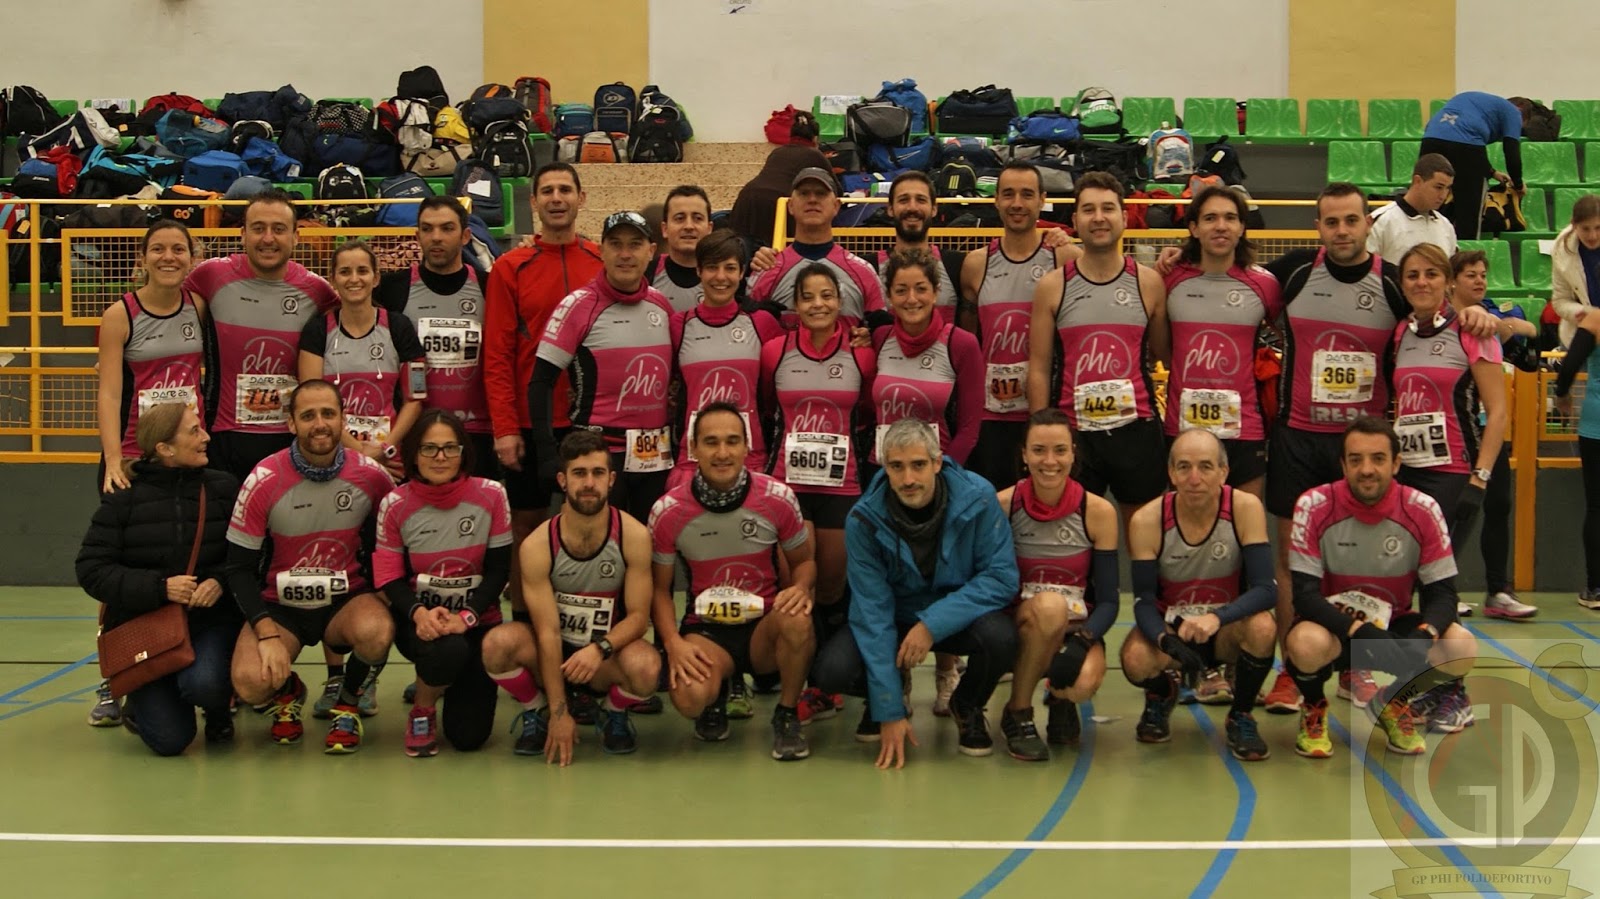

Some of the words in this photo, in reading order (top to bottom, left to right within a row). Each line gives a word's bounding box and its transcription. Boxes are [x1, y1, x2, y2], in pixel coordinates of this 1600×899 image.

[174, 208, 190, 220] GO
[424, 336, 460, 352] 6593
[242, 341, 285, 375] phi
[1074, 337, 1116, 388] phi
[1182, 335, 1225, 383] phi
[1323, 367, 1356, 385] 366
[616, 360, 660, 412] phi
[698, 371, 737, 412] phi
[992, 378, 1019, 395] 317
[247, 388, 280, 405] 774
[882, 387, 917, 424] phi
[1084, 395, 1116, 413] 442
[1398, 378, 1426, 416] phi
[791, 401, 829, 433] phi
[1190, 403, 1221, 420] 198
[636, 435, 659, 453] 984
[790, 451, 827, 469] 6605
[283, 585, 326, 601] 6538
[707, 602, 741, 618] 415
